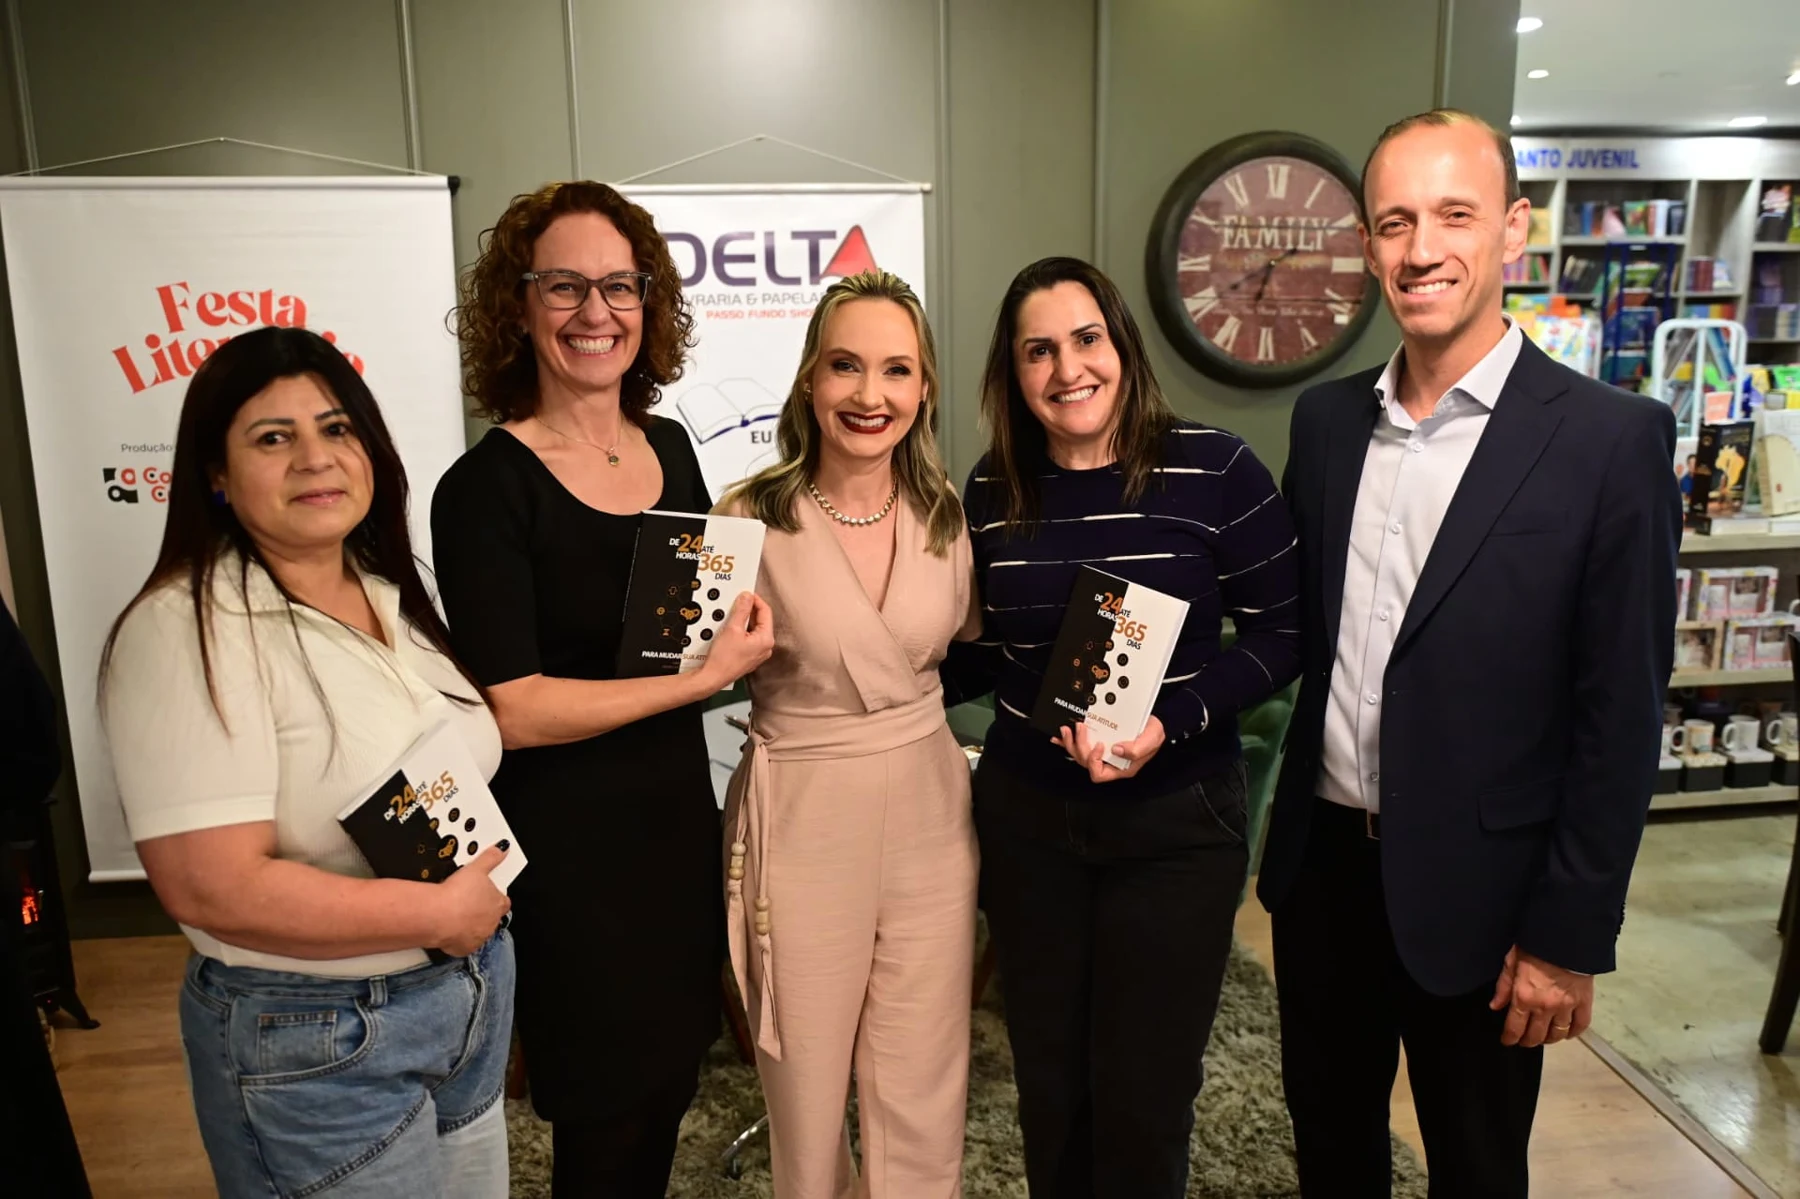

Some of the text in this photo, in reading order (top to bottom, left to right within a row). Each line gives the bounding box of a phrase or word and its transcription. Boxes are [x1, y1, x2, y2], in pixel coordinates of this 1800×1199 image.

[1566, 149, 1639, 169] JUVENIL
[1221, 215, 1328, 251] FAMILY
[156, 280, 307, 333] Festa
[746, 293, 757, 305] &
[762, 291, 825, 305] PAPELA
[706, 308, 814, 319] PASSO FUNDO SHO
[751, 430, 772, 444] EU
[121, 443, 173, 454] Produção
[669, 533, 705, 553] DE 24
[675, 551, 701, 561] HORAS
[697, 553, 735, 573] 365
[714, 572, 731, 580] DIAS
[1094, 591, 1124, 614] DE 24
[1114, 615, 1148, 642] 365
[641, 650, 658, 658] PARA
[1126, 638, 1142, 650] DIAS
[1054, 696, 1068, 708] PARA
[1098, 715, 1119, 731] ATITUDE
[390, 783, 417, 818] 24
[420, 770, 454, 811] 365
[443, 786, 460, 803] DIAS
